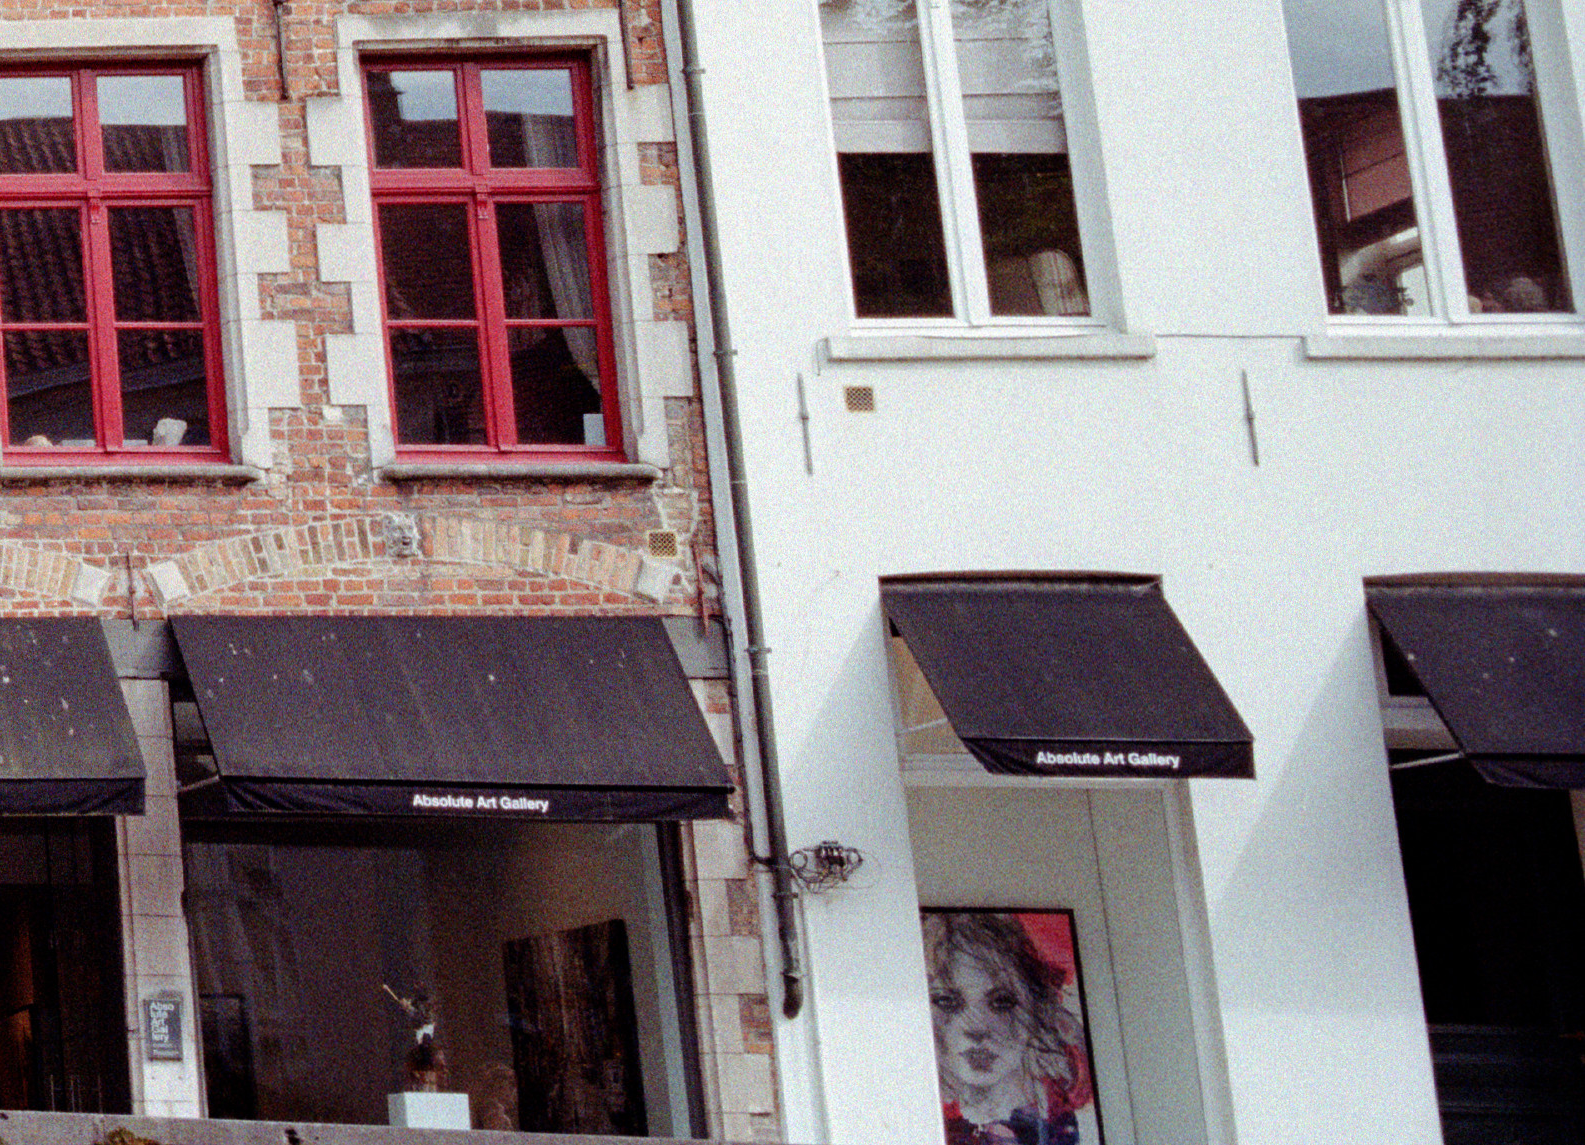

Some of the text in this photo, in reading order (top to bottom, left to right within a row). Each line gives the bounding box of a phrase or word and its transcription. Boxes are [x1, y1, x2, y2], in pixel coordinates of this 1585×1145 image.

[1036, 751, 1180, 769] Absolute Art Gallery
[413, 794, 549, 813] Absolute Art Gallery
